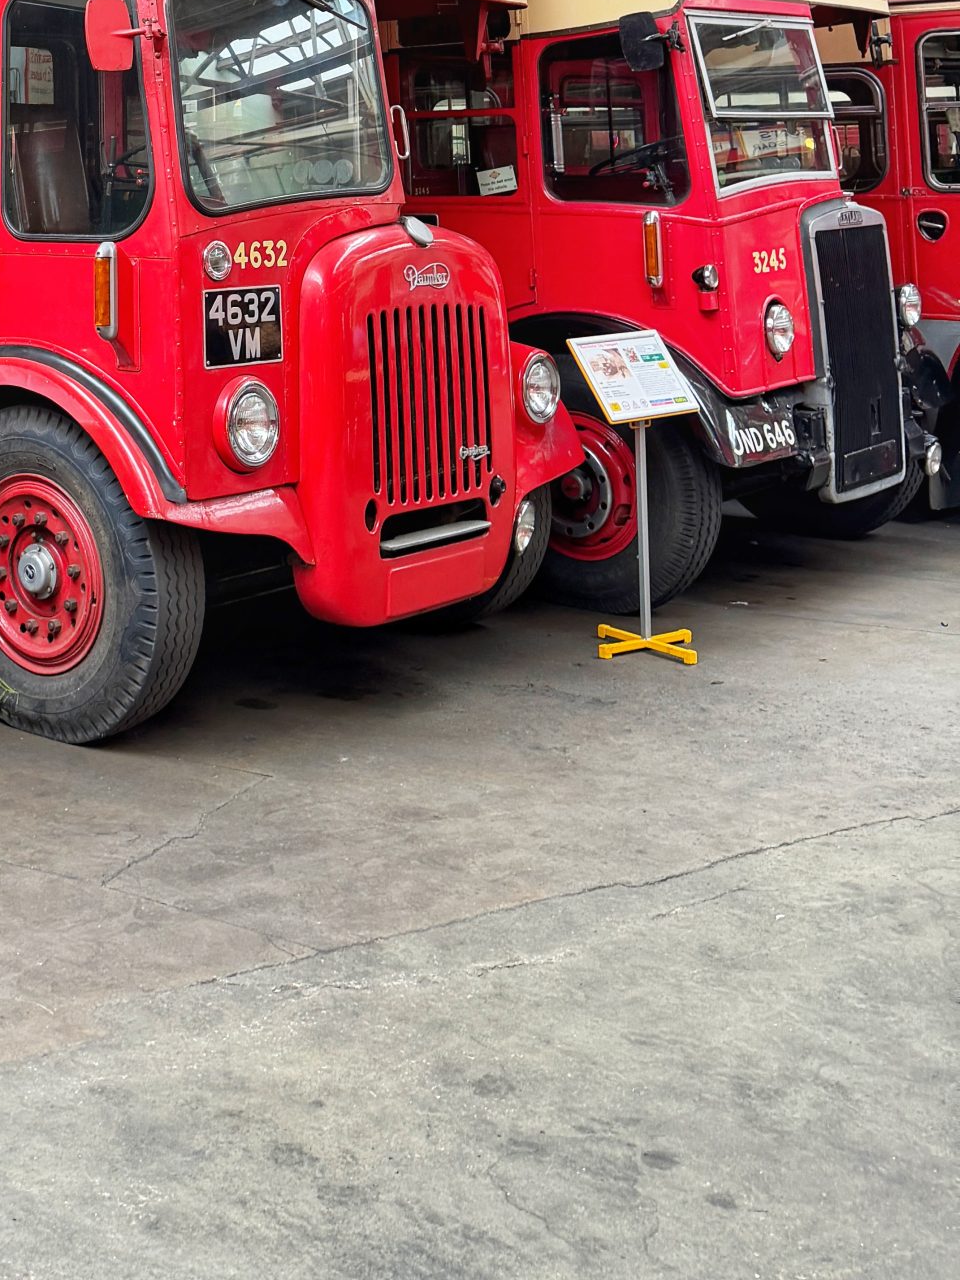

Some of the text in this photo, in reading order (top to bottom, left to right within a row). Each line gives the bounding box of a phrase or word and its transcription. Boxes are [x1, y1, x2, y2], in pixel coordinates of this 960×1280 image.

[233, 239, 288, 269] 4632
[752, 248, 787, 274] 3245
[208, 291, 276, 326] 4632
[228, 326, 261, 360] VM
[763, 420, 795, 449] 646
